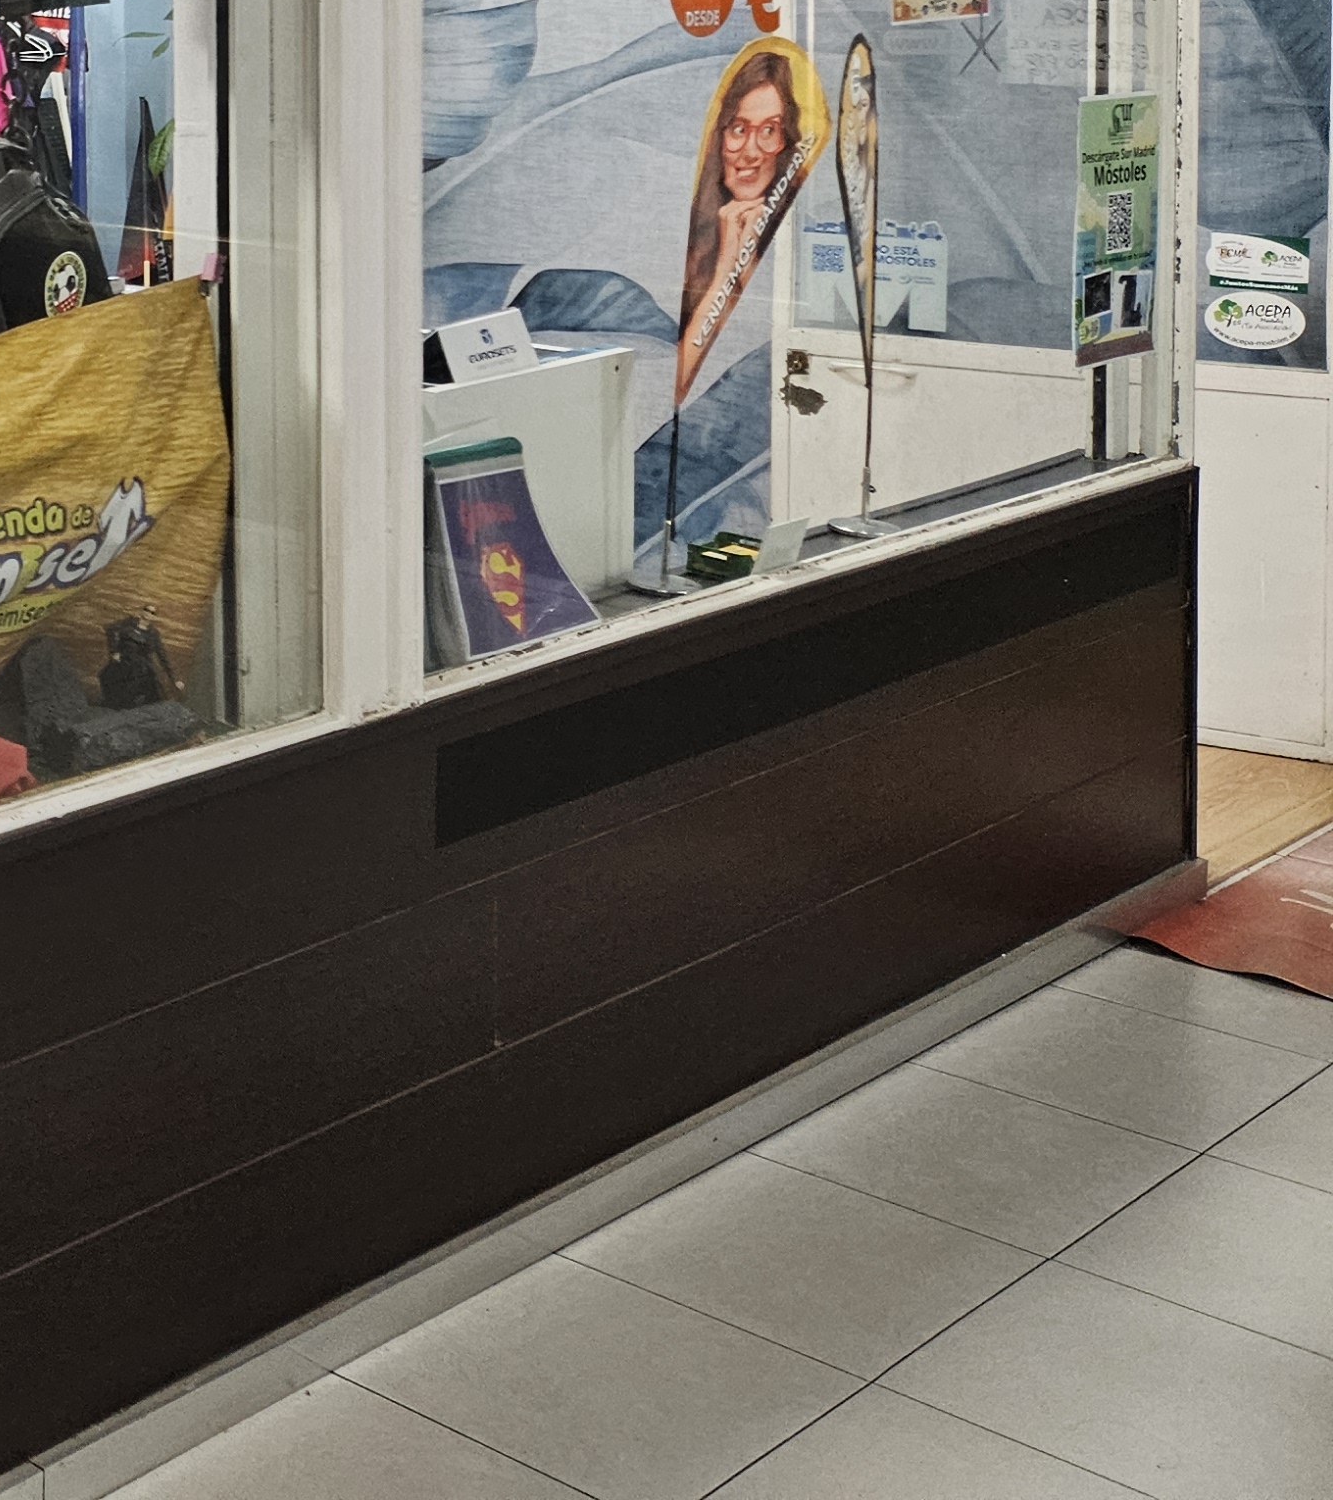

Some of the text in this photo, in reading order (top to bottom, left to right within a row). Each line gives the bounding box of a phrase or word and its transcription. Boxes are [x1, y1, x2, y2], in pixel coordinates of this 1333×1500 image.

[685, 9, 720, 27] DESDE
[1081, 151, 1120, 166] Descárgate
[1132, 146, 1157, 160] Madrid
[1093, 163, 1148, 186] Móstoles
[693, 131, 816, 348] VENDEMOS BANDERAS
[1244, 304, 1292, 319] ACEPA
[70, 505, 92, 528] de
